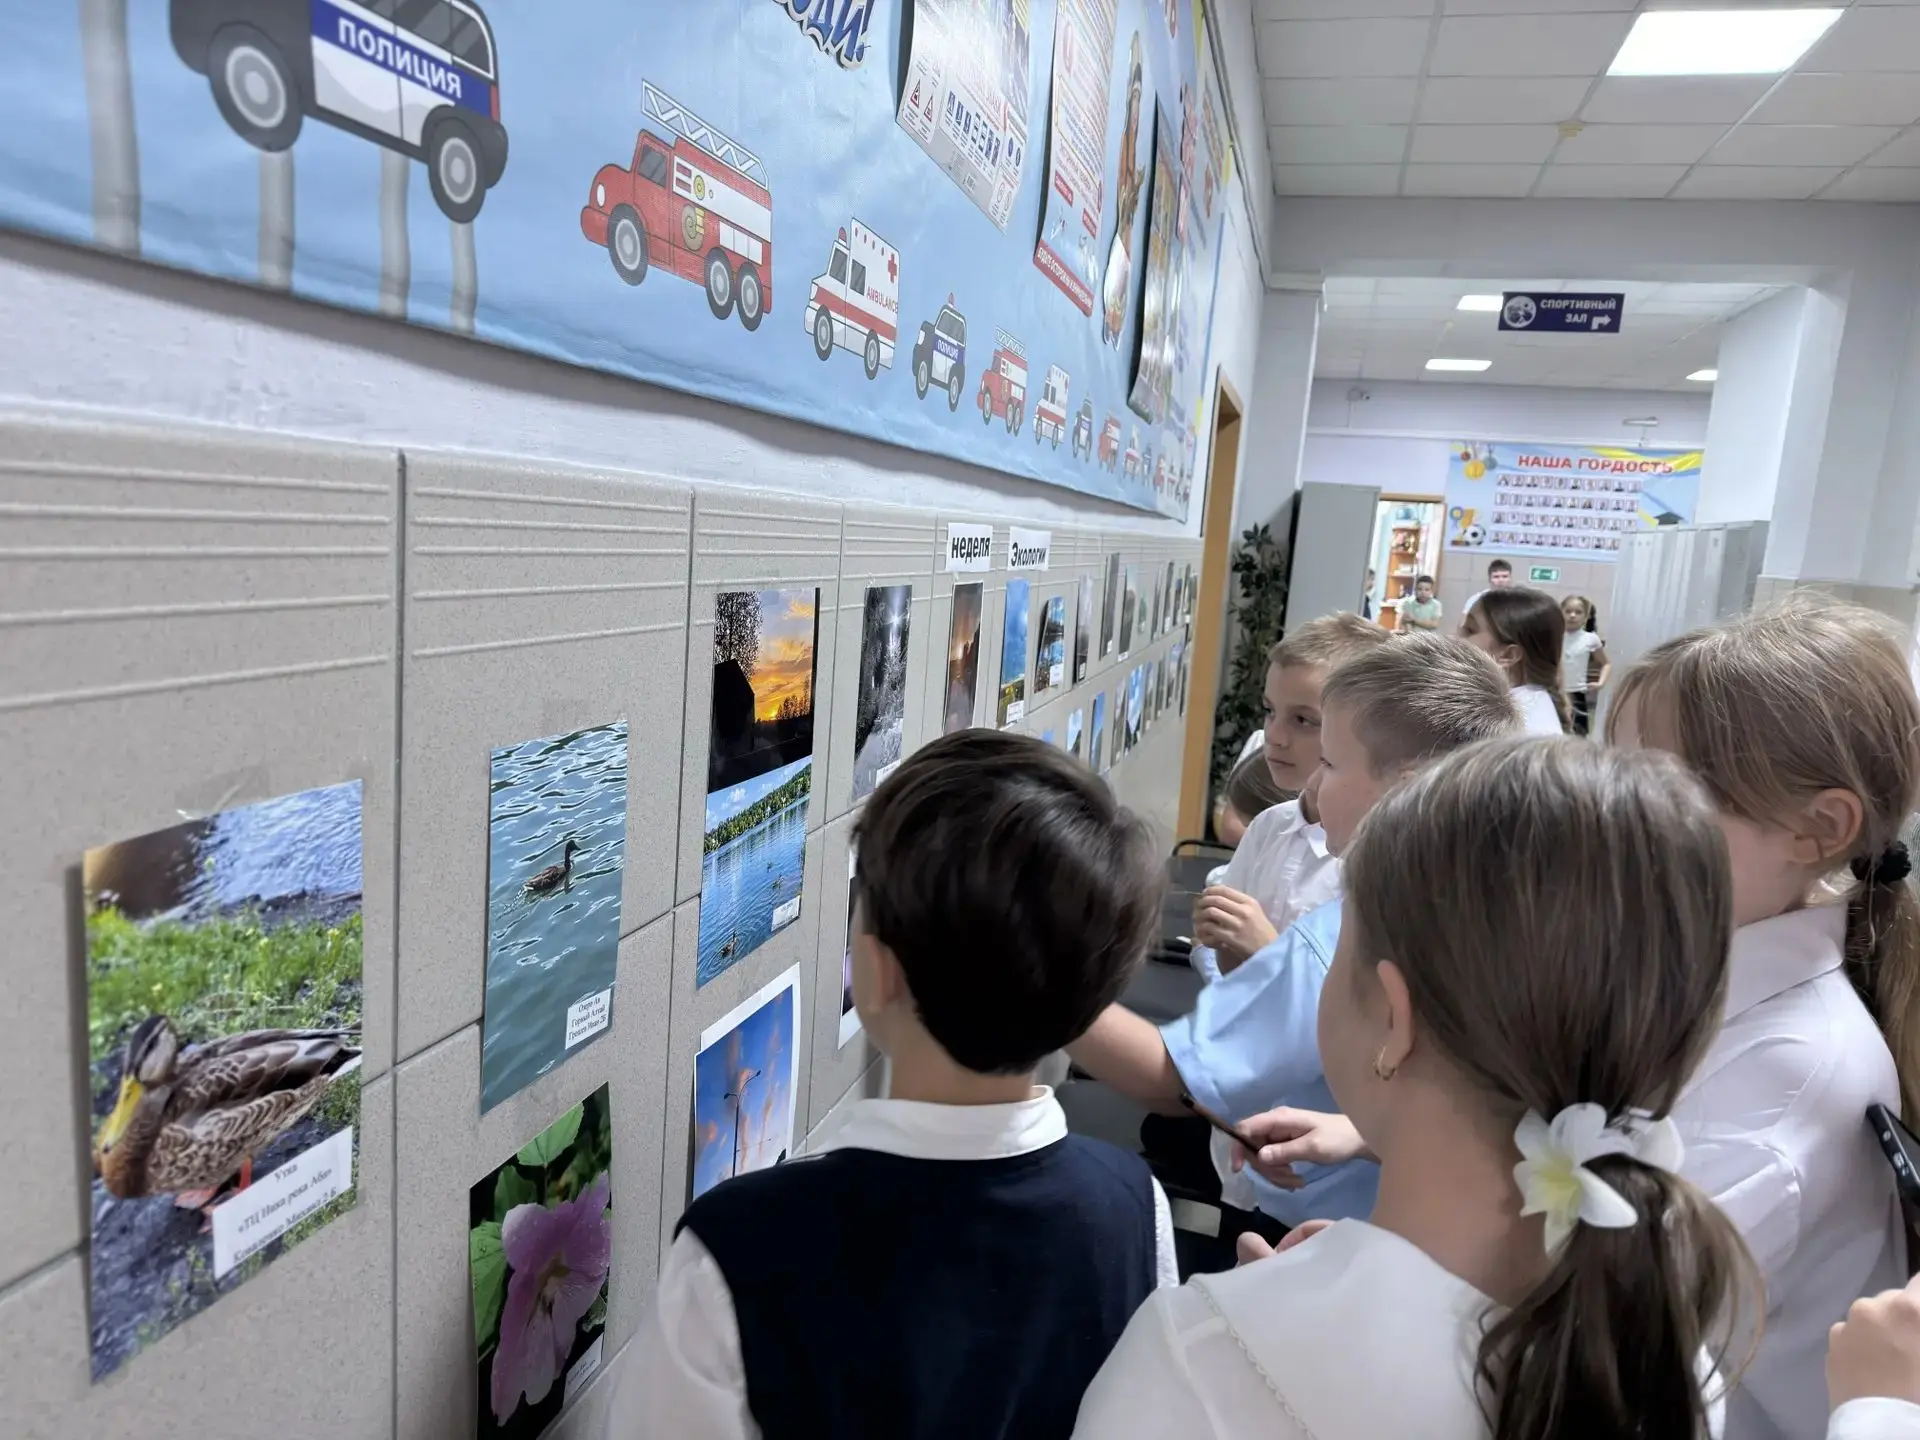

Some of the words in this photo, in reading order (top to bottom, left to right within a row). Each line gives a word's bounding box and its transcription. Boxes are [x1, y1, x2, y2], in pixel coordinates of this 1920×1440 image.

[338, 17, 462, 100] ПОЛИЦИЯ
[866, 286, 898, 314] AMBULANCE
[1540, 298, 1616, 310] СПОРТИВНЫЙ
[1565, 313, 1588, 323] ЗАЛ
[1518, 455, 1572, 468] НАША
[1578, 458, 1673, 474] ГОРДОСТЬ
[951, 536, 991, 564] неделя
[1011, 542, 1047, 567] Экологии
